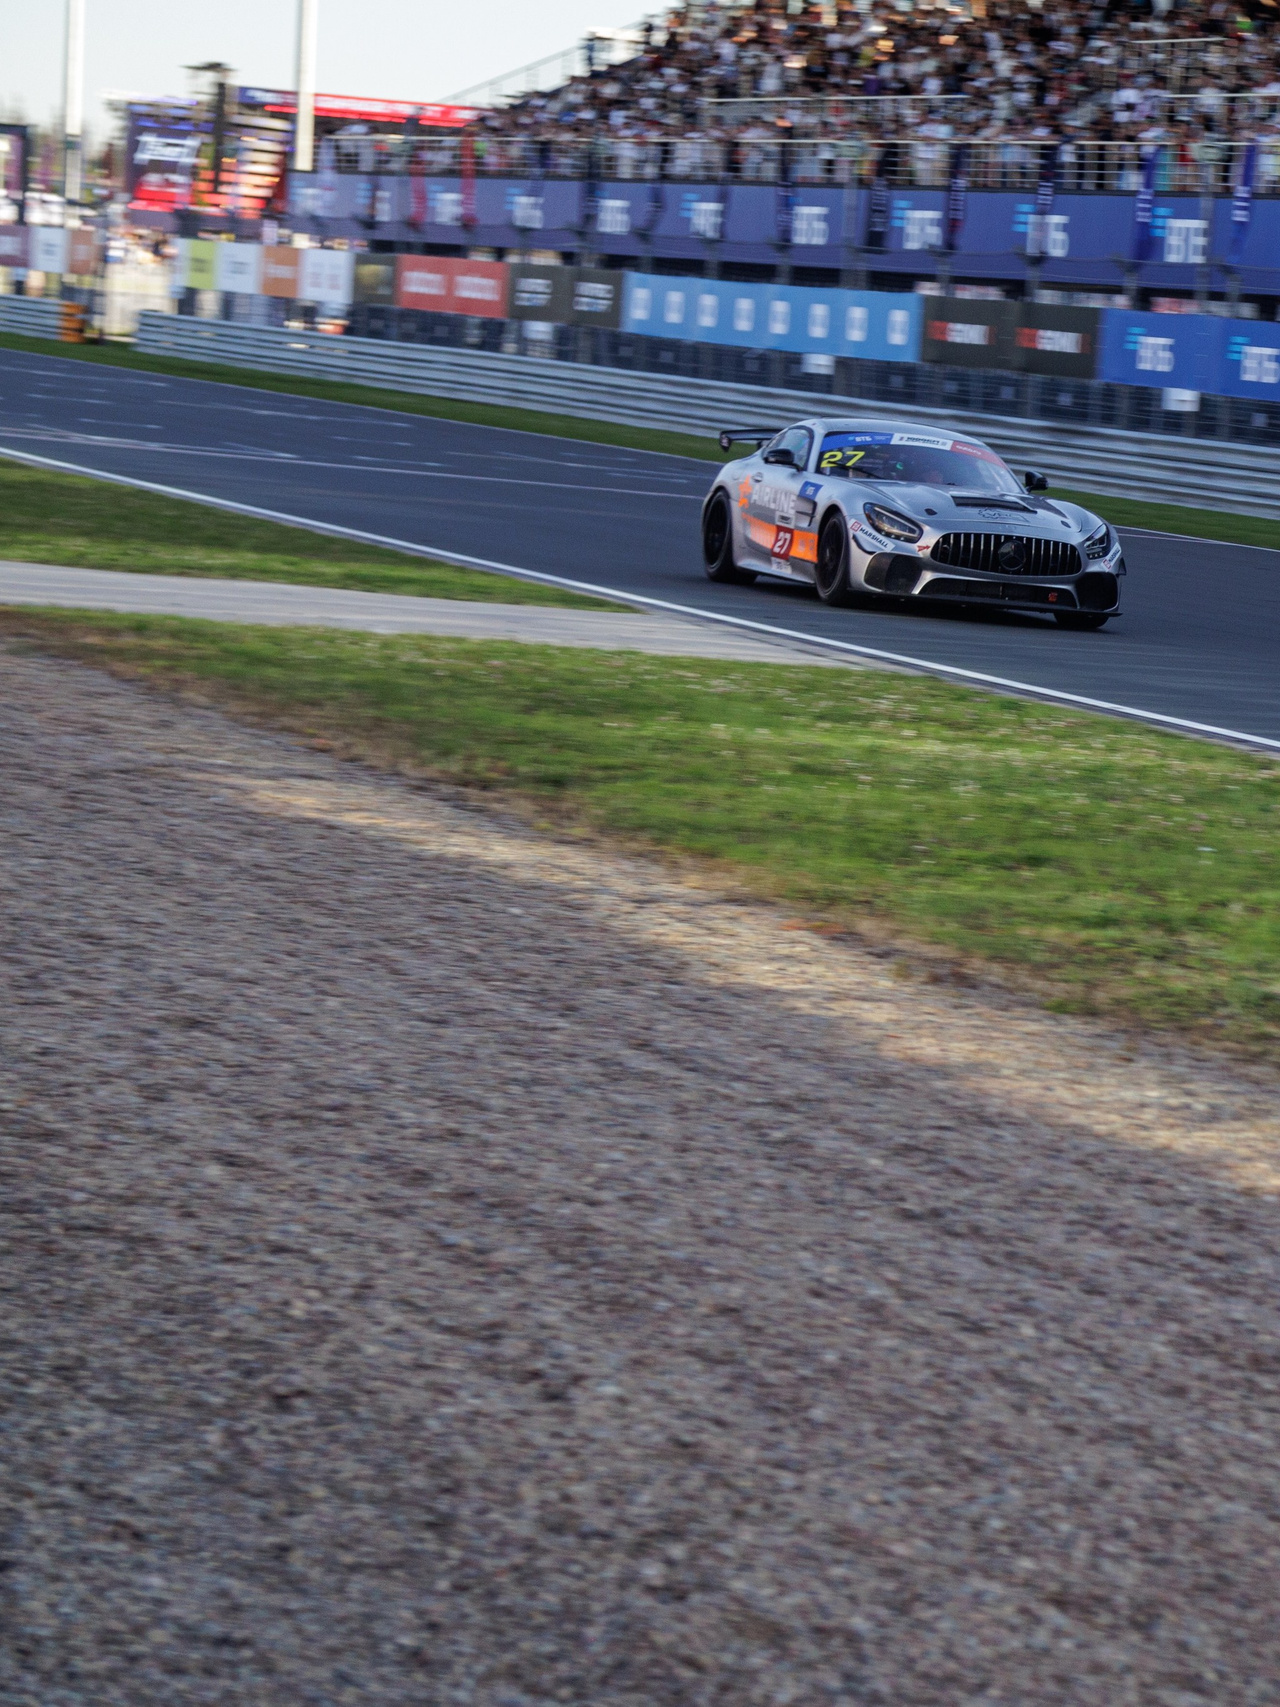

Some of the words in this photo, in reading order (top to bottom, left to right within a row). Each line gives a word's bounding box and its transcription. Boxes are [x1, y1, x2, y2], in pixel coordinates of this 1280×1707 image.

[820, 451, 866, 468] 27
[751, 483, 798, 514] AIRLINE
[772, 531, 792, 555] 27
[858, 526, 890, 549] MARSHALL
